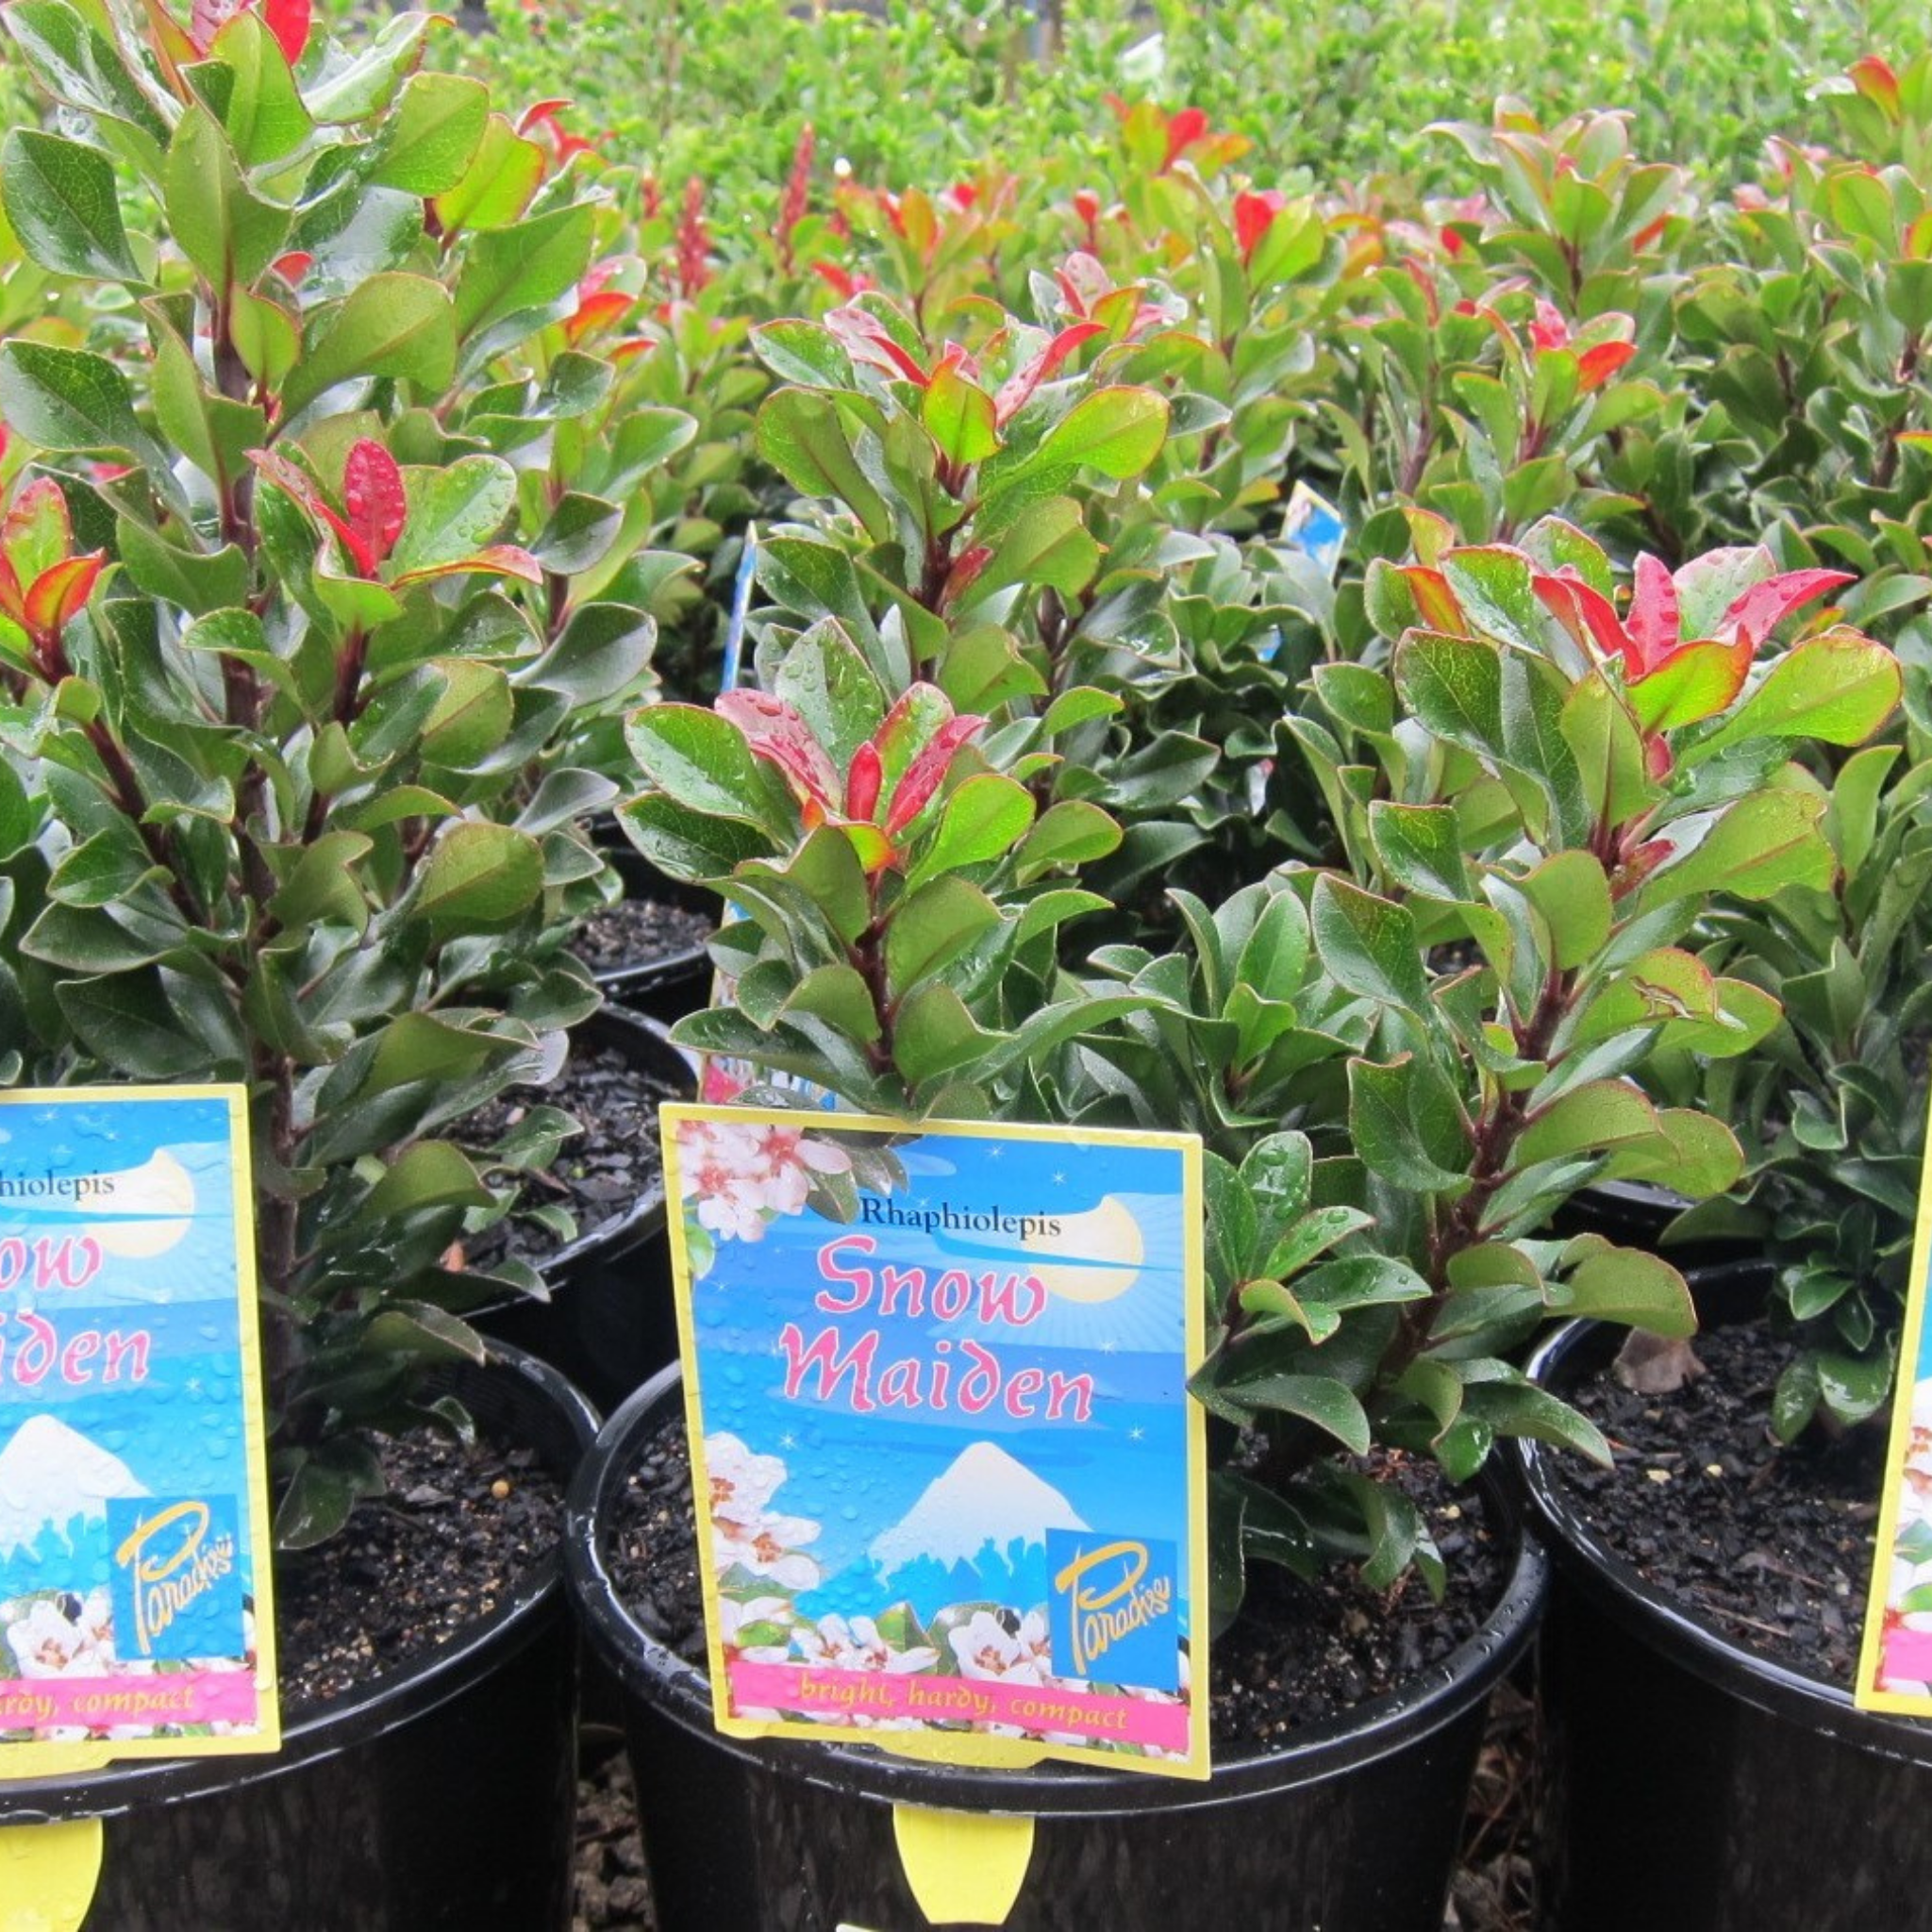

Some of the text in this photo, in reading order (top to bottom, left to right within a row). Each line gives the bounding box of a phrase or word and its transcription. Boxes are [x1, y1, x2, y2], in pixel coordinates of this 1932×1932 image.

[860, 1196, 1061, 1241] Rhaphiolepis
[815, 1234, 1049, 1326] Snow
[778, 1322, 1094, 1422] Maiden
[1055, 1541, 1172, 1675] Paradise
[74, 1685, 194, 1719] compact
[801, 1671, 1128, 1730] bright, hardy, compact
